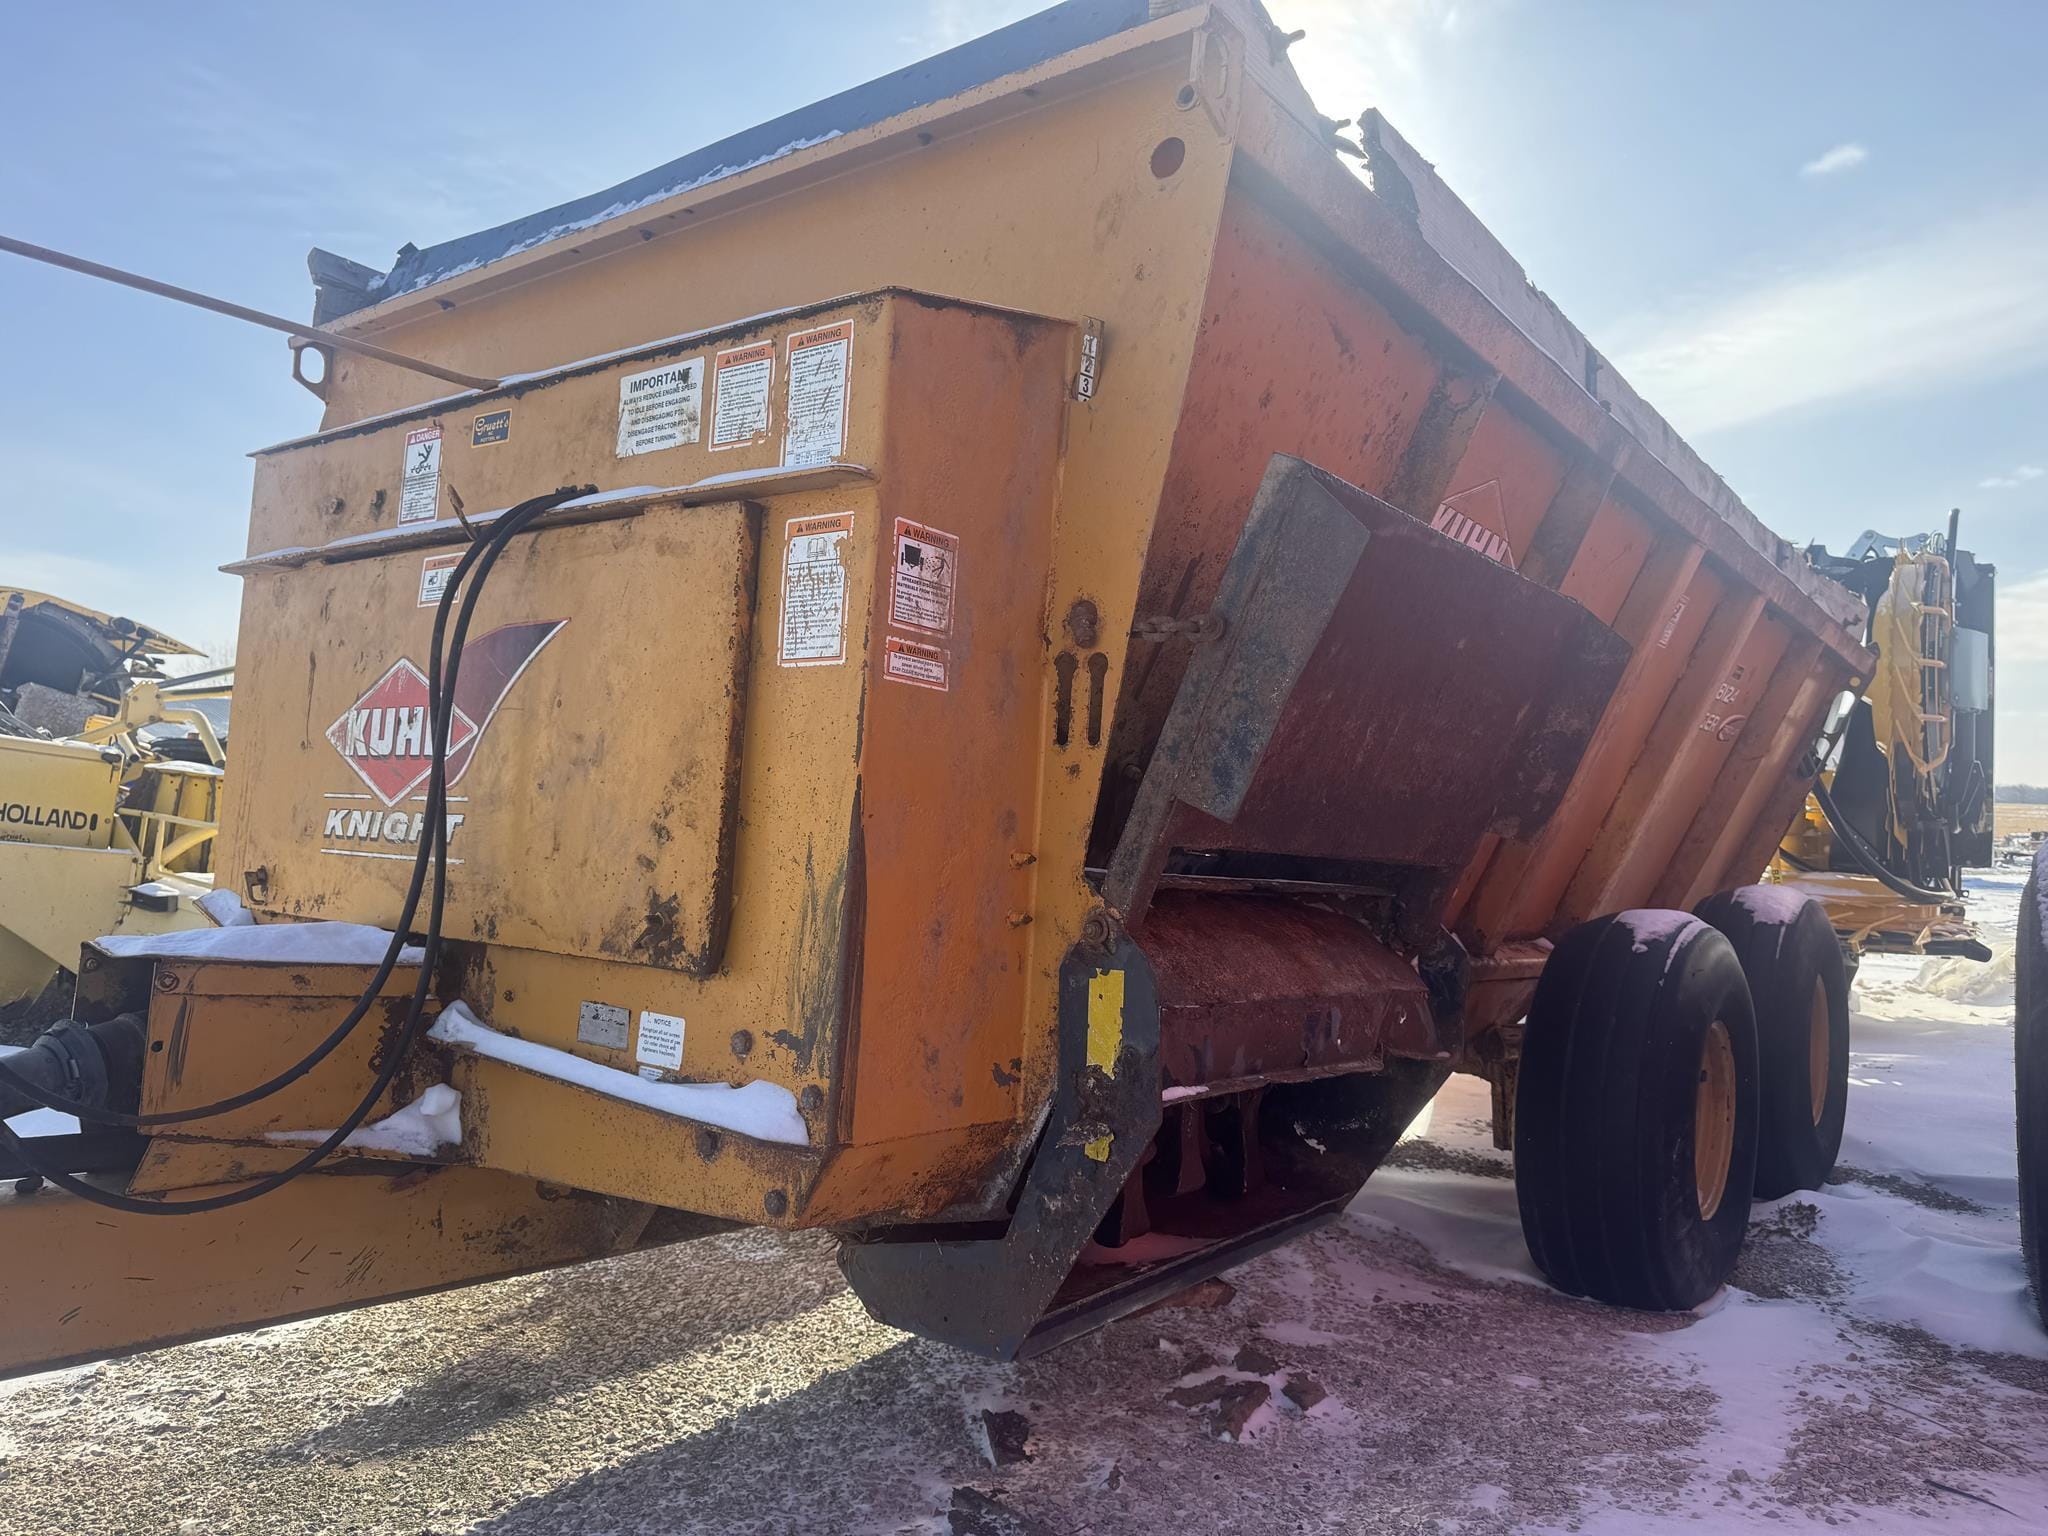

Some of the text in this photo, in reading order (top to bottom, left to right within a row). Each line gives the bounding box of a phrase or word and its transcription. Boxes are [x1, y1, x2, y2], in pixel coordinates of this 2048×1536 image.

[806, 328, 842, 344] WARNING
[732, 348, 765, 362] WARNING
[630, 367, 692, 394] IMPORTANT
[1082, 378, 1089, 393] 3
[643, 390, 661, 402] REDUCE
[681, 382, 697, 392] SPEED
[645, 401, 665, 412] BEFORE
[665, 395, 691, 406] ENGAGING
[475, 415, 509, 436] Gruett's
[627, 426, 654, 438] DISENGAGE
[654, 421, 677, 432] TRACTOR
[416, 429, 440, 442] DANGER
[805, 519, 841, 531] WARNING
[1430, 503, 1509, 563] KUHN
[913, 528, 950, 548] WARNING
[906, 644, 938, 660] WARNING
[323, 809, 465, 844] KNIGHT
[653, 1018, 672, 1028] NOTICE
